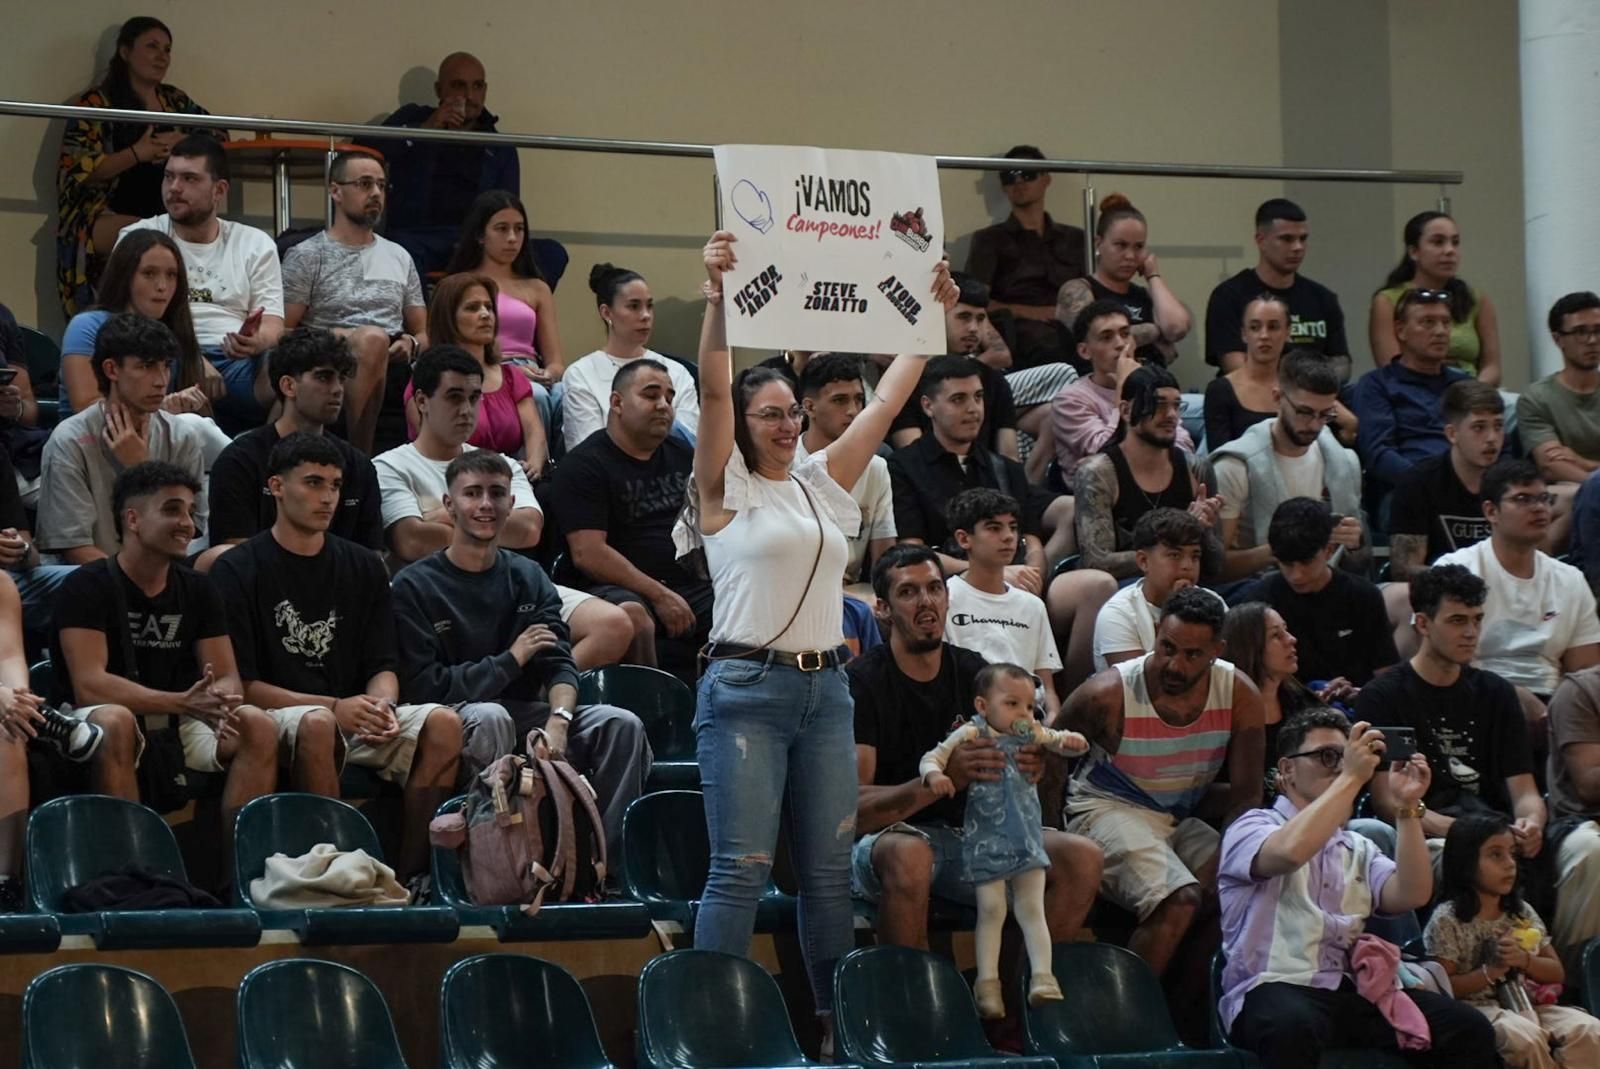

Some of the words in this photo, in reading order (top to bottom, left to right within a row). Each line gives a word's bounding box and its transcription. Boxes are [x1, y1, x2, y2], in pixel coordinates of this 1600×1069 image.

[795, 174, 871, 218] ¡VAMOS
[786, 213, 882, 242] Campeones!
[733, 264, 779, 309] VICTOR
[813, 281, 858, 298] STEVE
[881, 275, 922, 316] AYOUB
[804, 295, 868, 314] ZORATTO
[1452, 522, 1493, 539] GUES
[127, 611, 183, 641] EA7
[951, 613, 1029, 630] Champion
